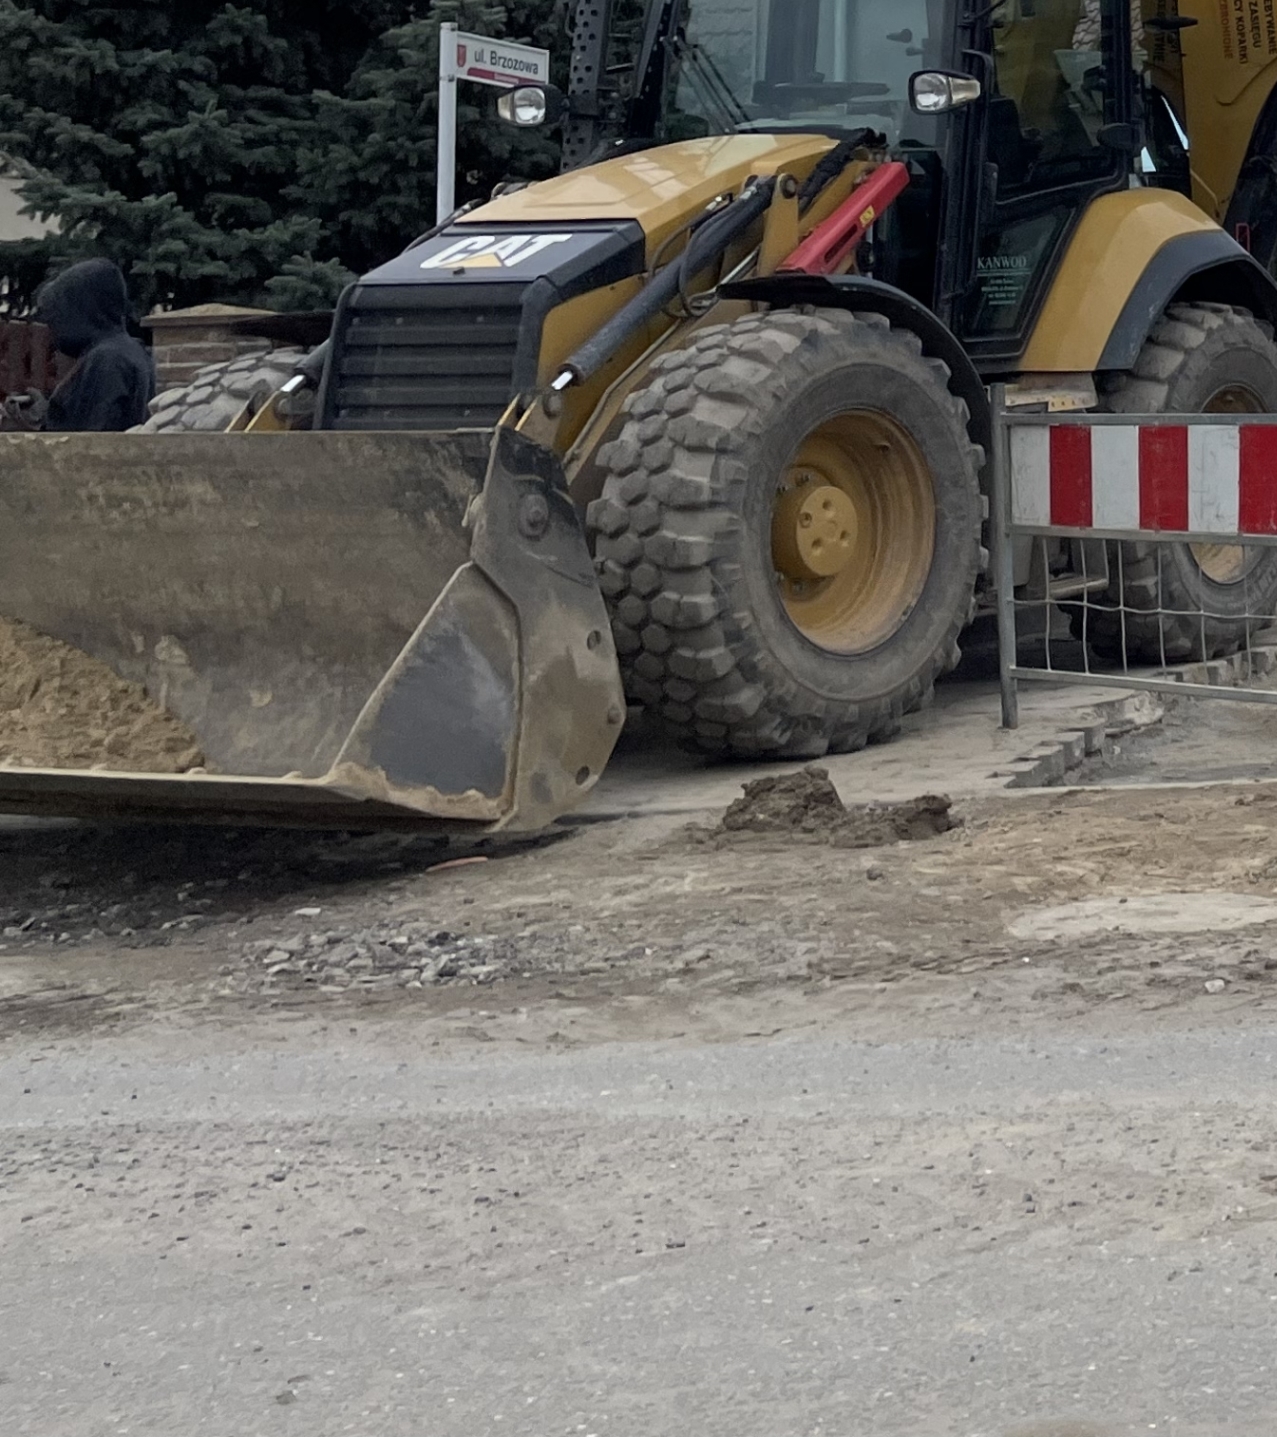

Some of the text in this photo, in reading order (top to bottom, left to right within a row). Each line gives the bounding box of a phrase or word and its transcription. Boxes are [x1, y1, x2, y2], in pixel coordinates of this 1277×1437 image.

[1235, 15, 1249, 64] KOPARKI
[474, 48, 539, 75] ul. Brzozowa
[420, 234, 573, 269] CAT
[976, 255, 1028, 270] KANWOD
